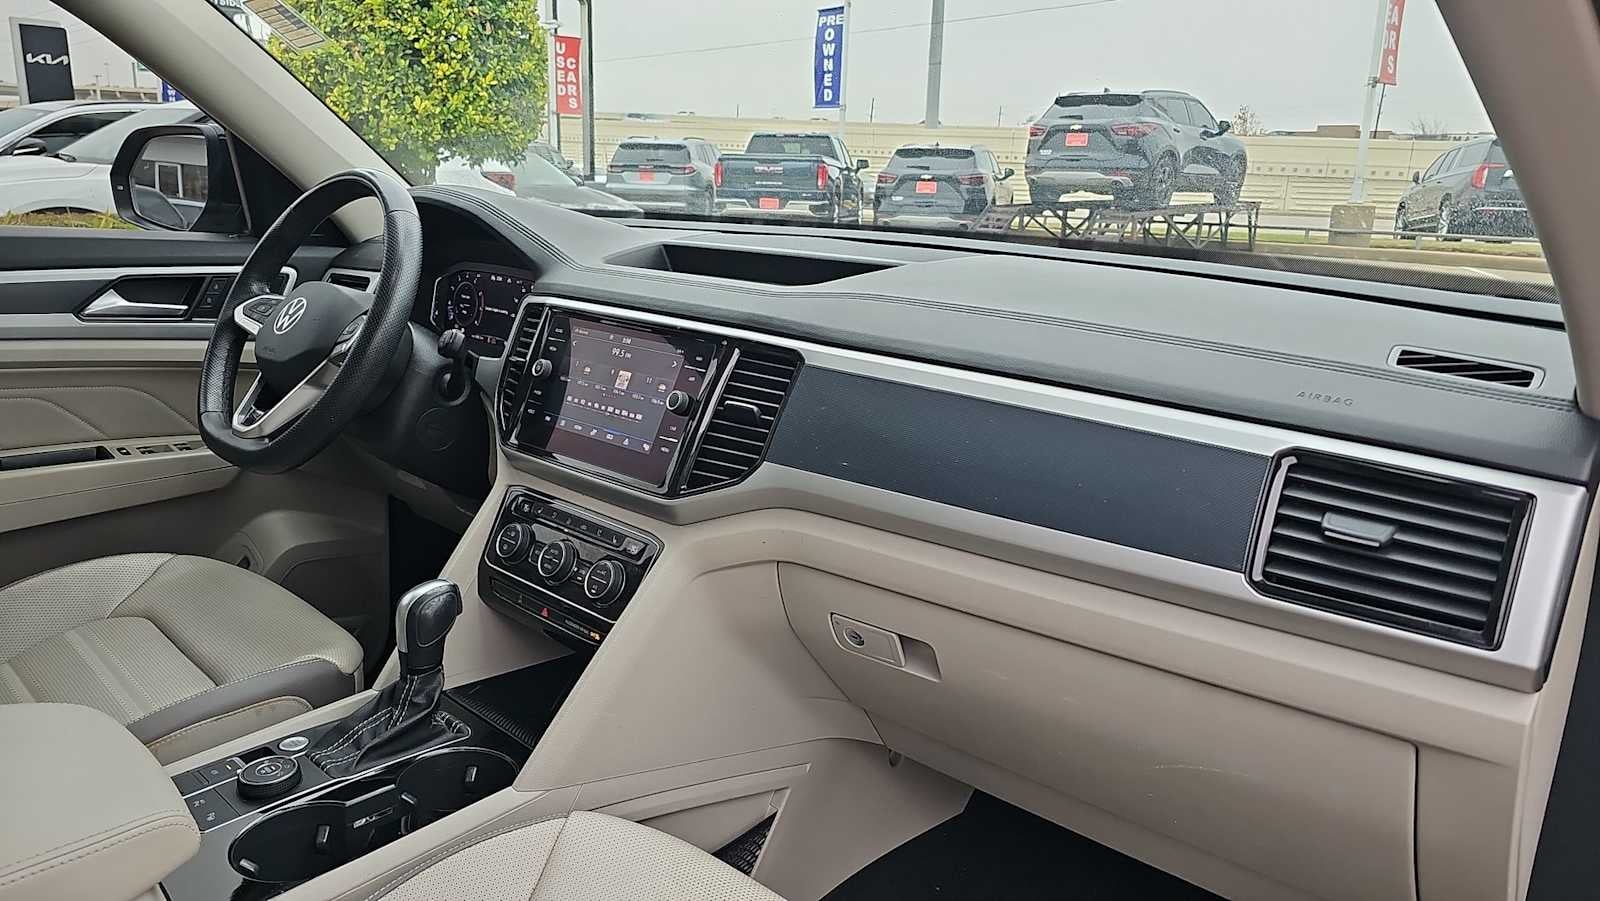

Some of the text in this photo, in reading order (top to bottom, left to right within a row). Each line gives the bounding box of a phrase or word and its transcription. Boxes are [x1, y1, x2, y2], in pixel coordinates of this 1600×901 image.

[818, 14, 845, 27] PRE
[556, 42, 566, 96] USED
[566, 57, 578, 109] CARS
[822, 28, 835, 102] OWNED
[1295, 391, 1354, 406] AIRBAG
